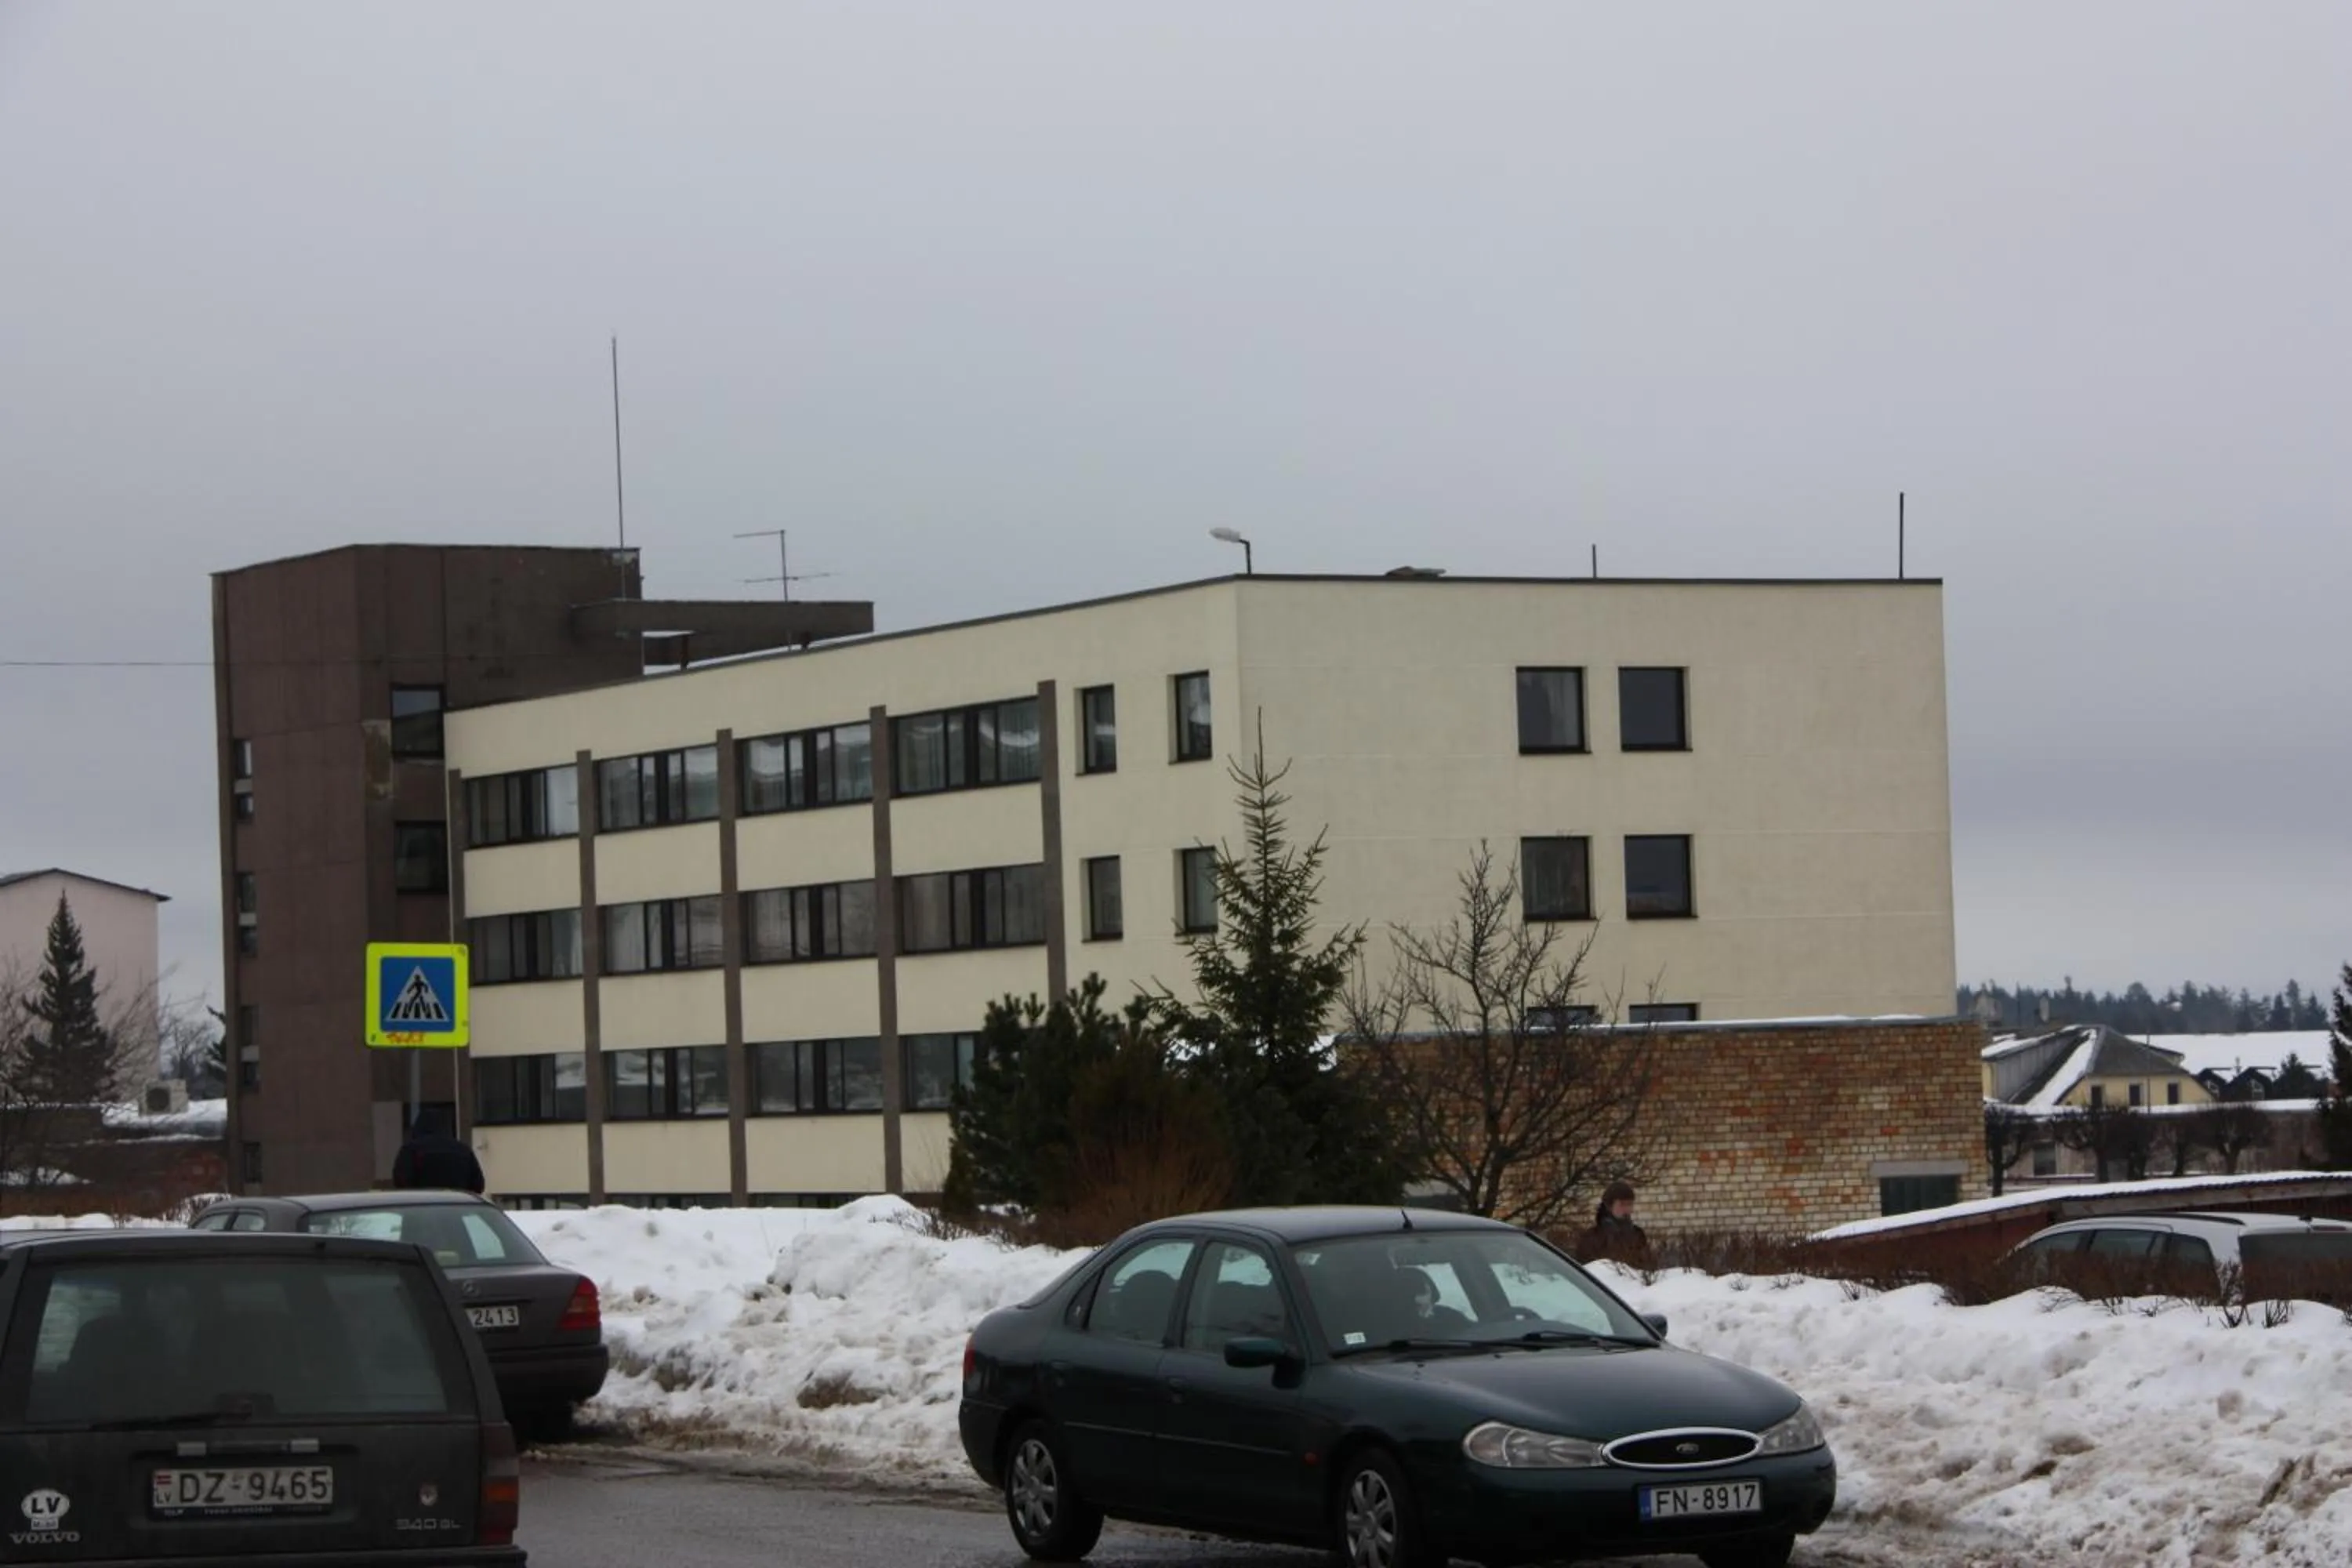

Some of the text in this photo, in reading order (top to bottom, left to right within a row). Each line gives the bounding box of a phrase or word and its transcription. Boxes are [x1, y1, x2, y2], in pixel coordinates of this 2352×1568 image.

[474, 1308, 517, 1326] 2413
[180, 1470, 327, 1503] DZ-9465
[31, 1497, 60, 1513] LV
[156, 1492, 171, 1504] LV
[1656, 1485, 1755, 1514] FN-8917
[9, 1530, 82, 1544] VOLVO
